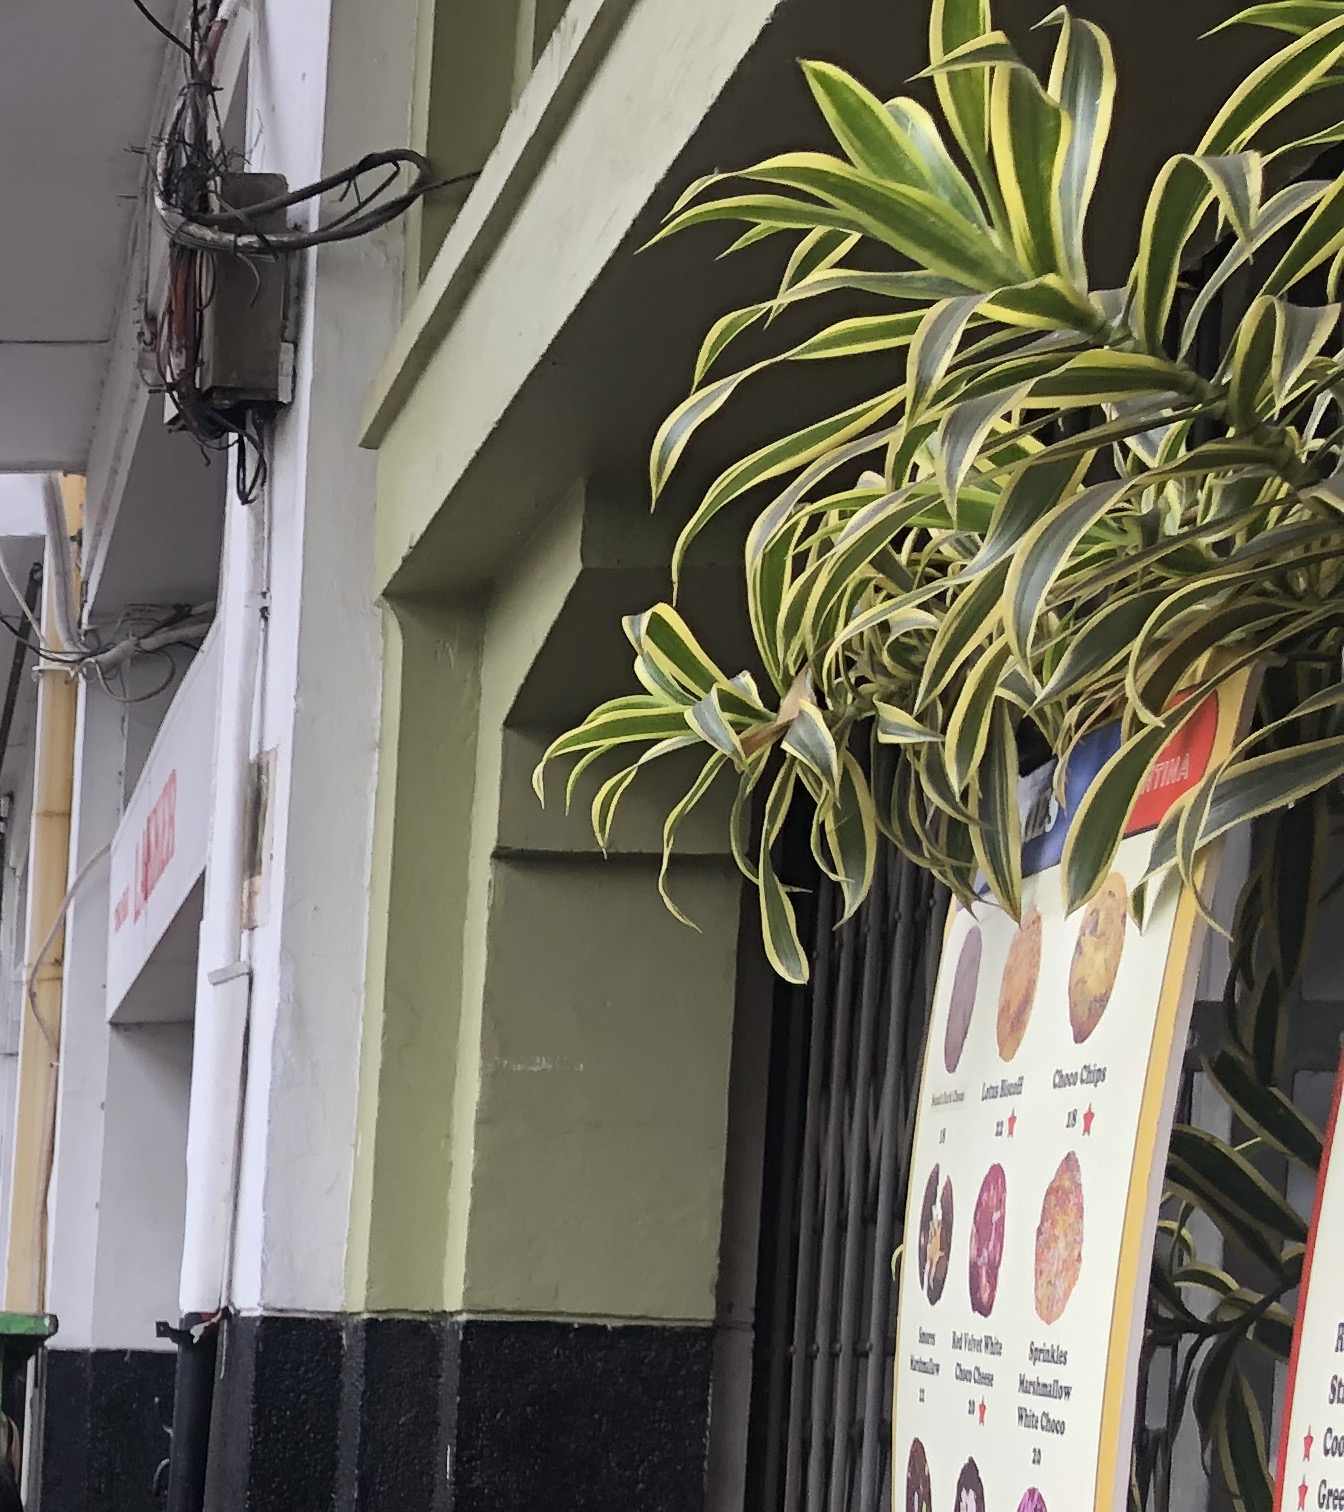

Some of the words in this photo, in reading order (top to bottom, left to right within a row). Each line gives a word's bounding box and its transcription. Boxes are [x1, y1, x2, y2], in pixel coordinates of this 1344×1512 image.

[1028, 1341, 1069, 1366] Sprinkles
[1018, 1373, 1072, 1401] Marshmallow
[1017, 1406, 1039, 1431] White
[1040, 1411, 1066, 1437] Choco
